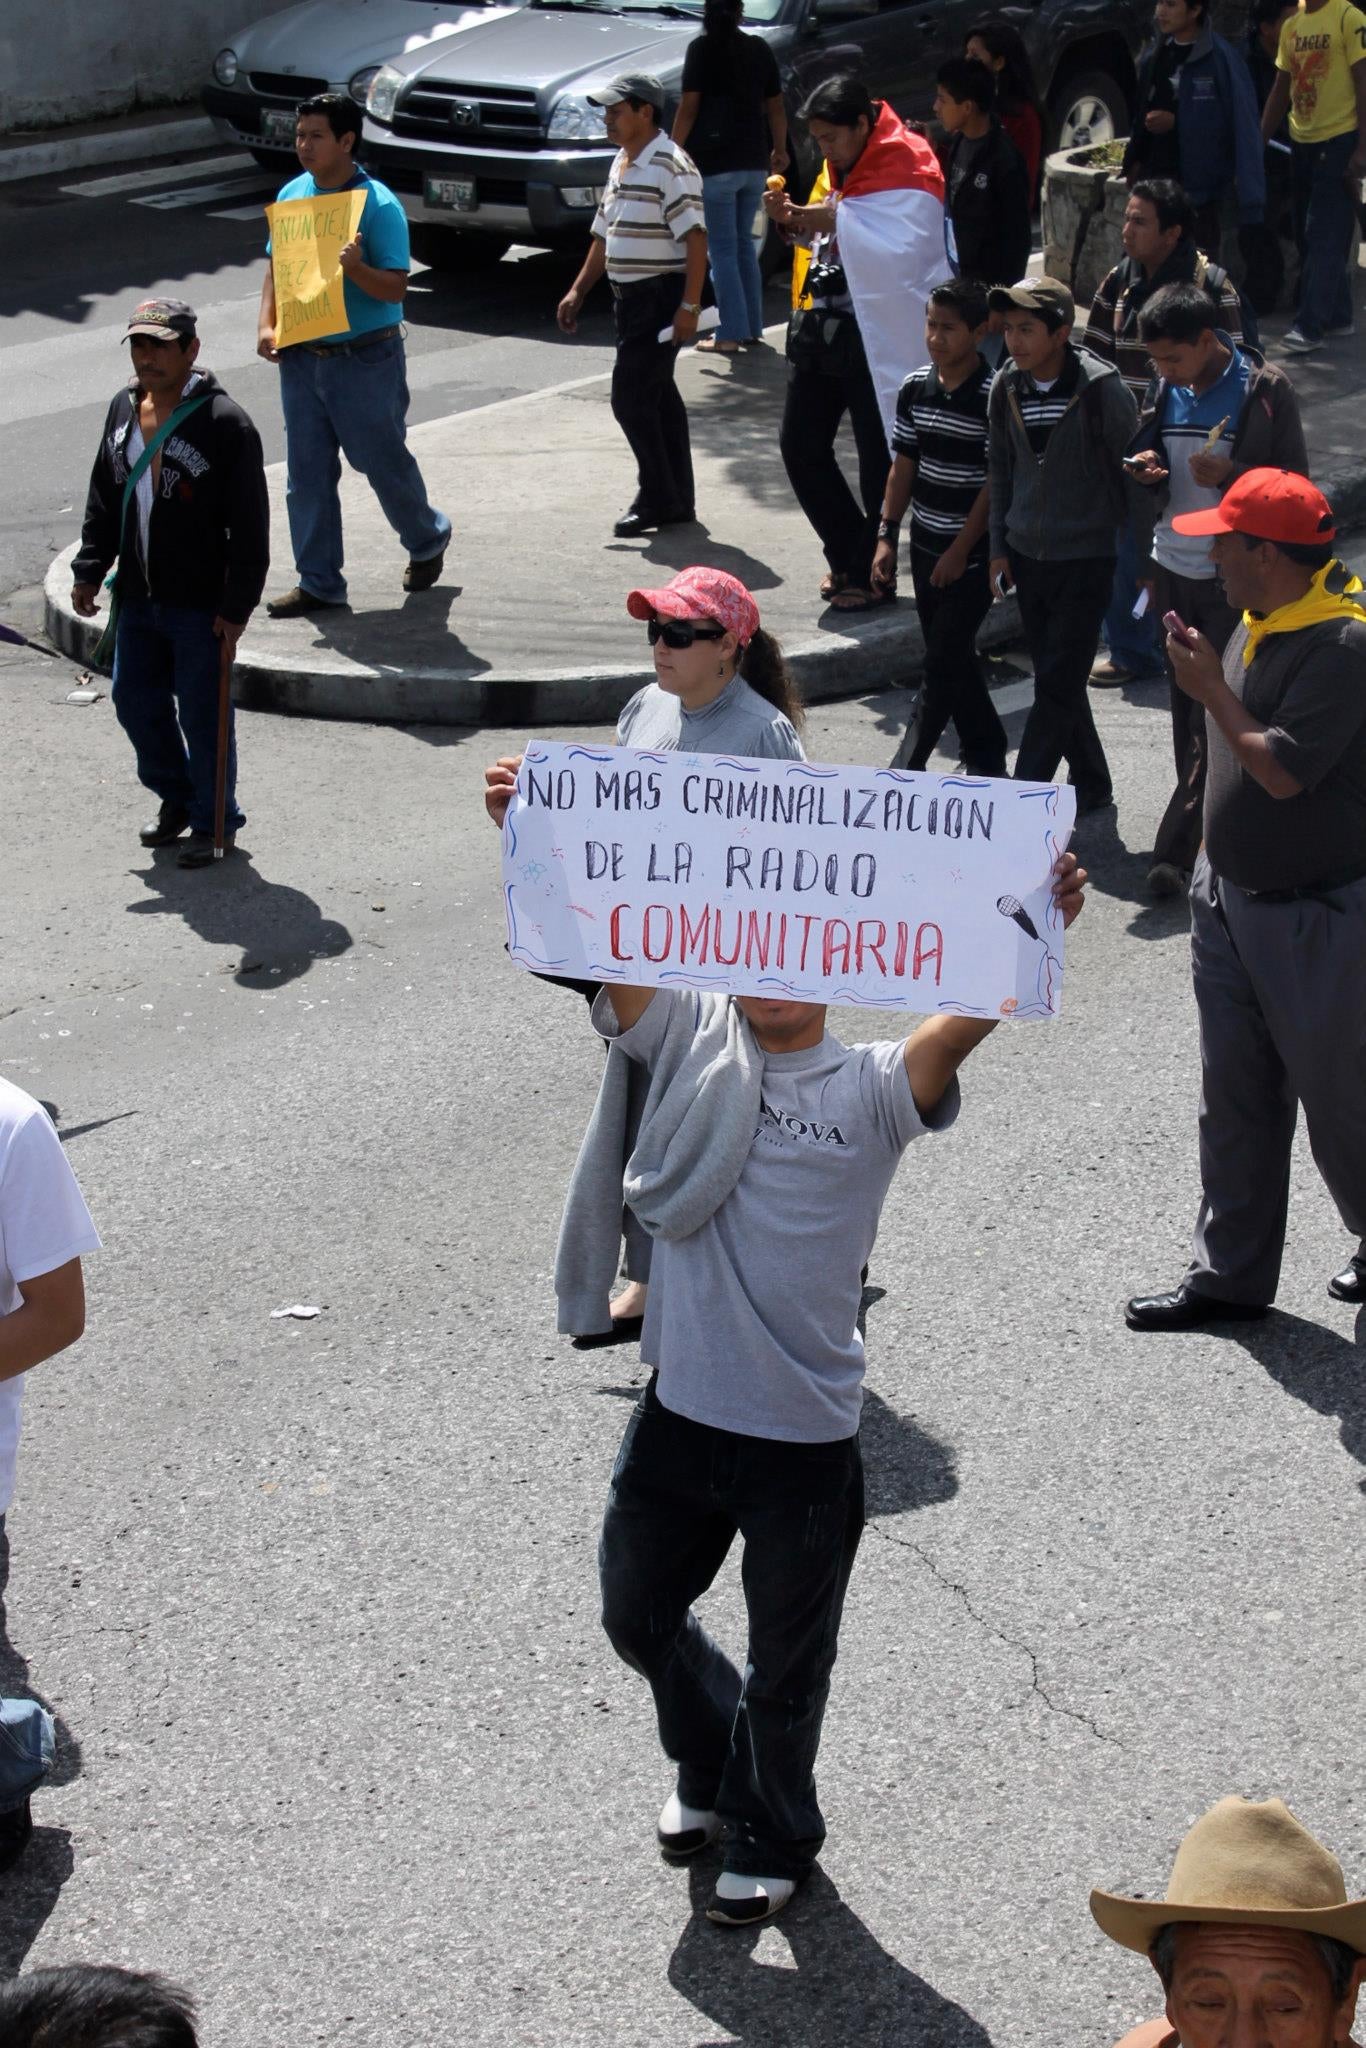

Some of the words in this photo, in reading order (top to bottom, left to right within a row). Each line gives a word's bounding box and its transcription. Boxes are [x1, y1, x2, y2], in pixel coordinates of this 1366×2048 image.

[527, 768, 575, 811] NO
[595, 769, 660, 810] MAS
[683, 775, 994, 841] CRIMINALIZACION
[585, 840, 624, 881] DE
[648, 841, 692, 885] LA
[726, 846, 876, 897] RADIO
[610, 903, 944, 986] COMUNITARIA
[760, 1097, 847, 1145] NOVA
